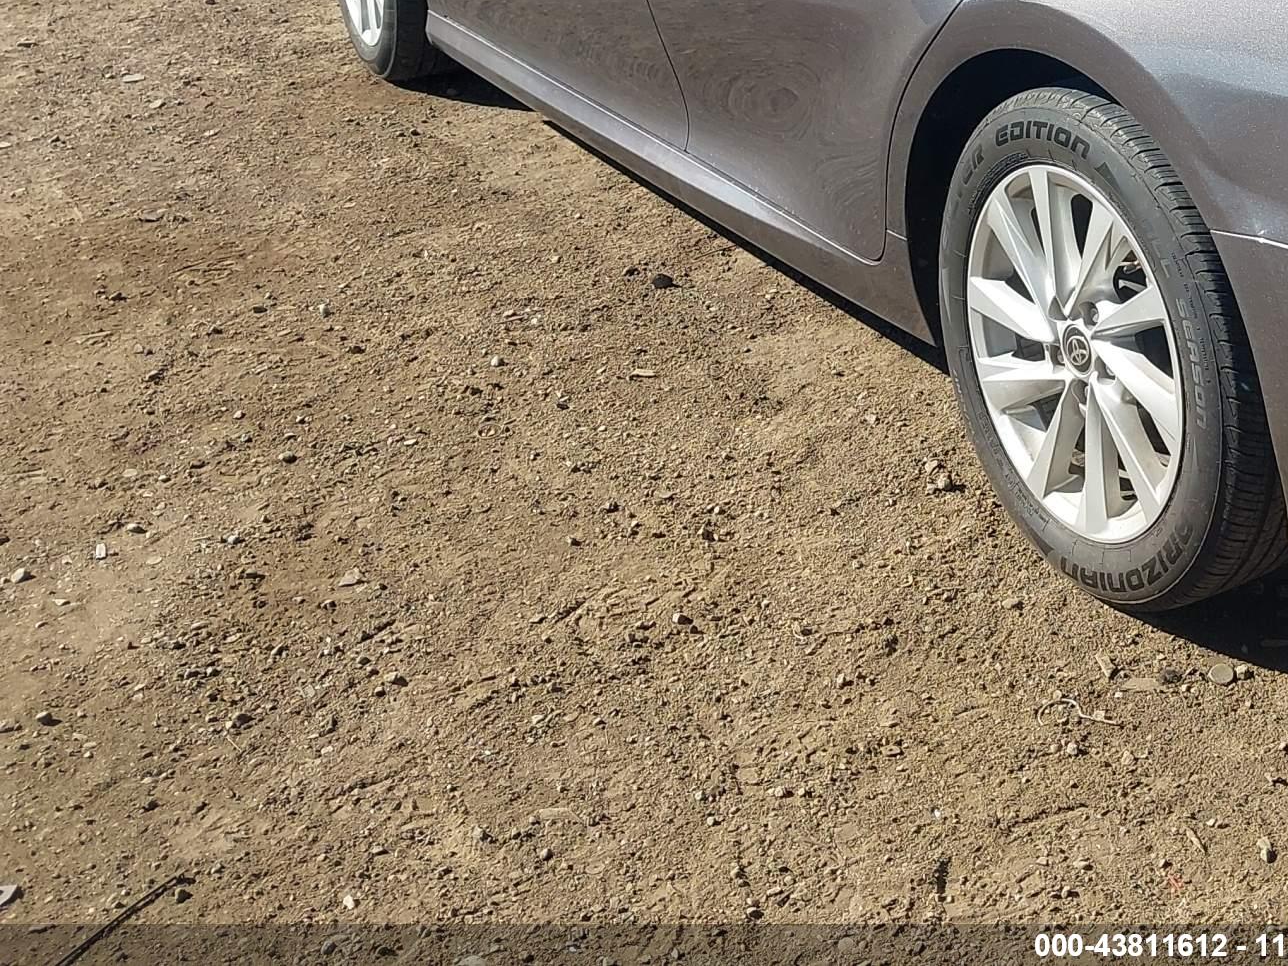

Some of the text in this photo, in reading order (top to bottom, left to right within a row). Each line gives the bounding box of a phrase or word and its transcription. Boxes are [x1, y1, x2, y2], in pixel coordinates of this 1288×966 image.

[995, 120, 1091, 160] EDITION
[1175, 297, 1207, 429] SEASON
[1060, 521, 1194, 593] ARIZONIAN
